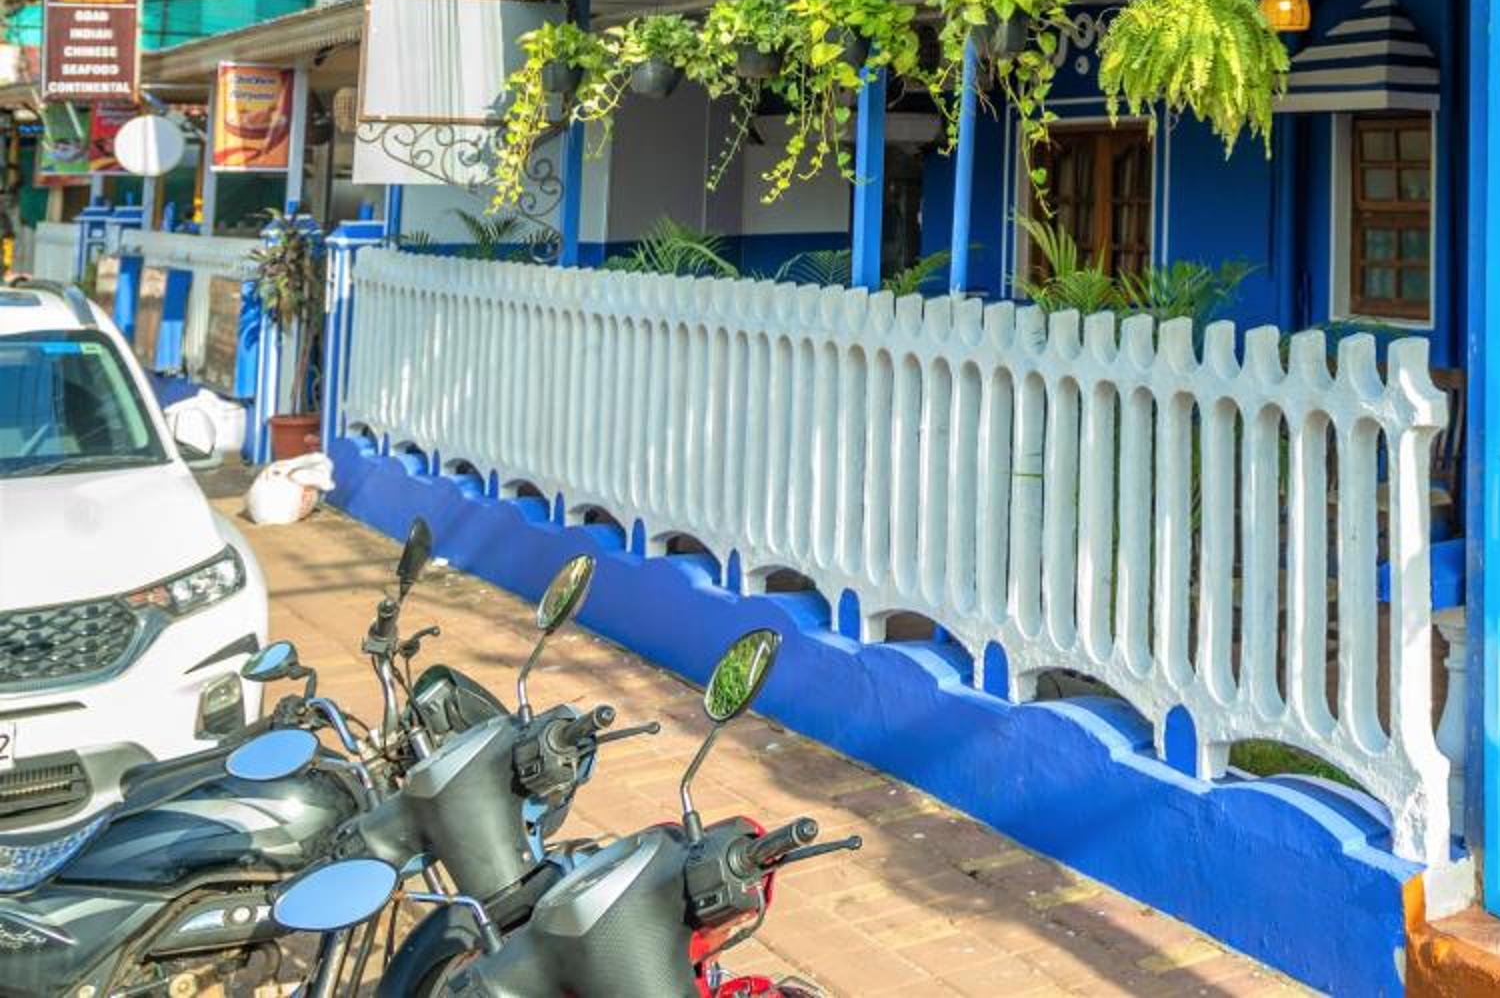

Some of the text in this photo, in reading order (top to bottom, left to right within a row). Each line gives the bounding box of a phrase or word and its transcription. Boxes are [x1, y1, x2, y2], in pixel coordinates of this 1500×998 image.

[63, 45, 118, 58] CHINESE
[61, 64, 120, 76] SEAFOOD
[48, 82, 131, 94] CONTINENTAL
